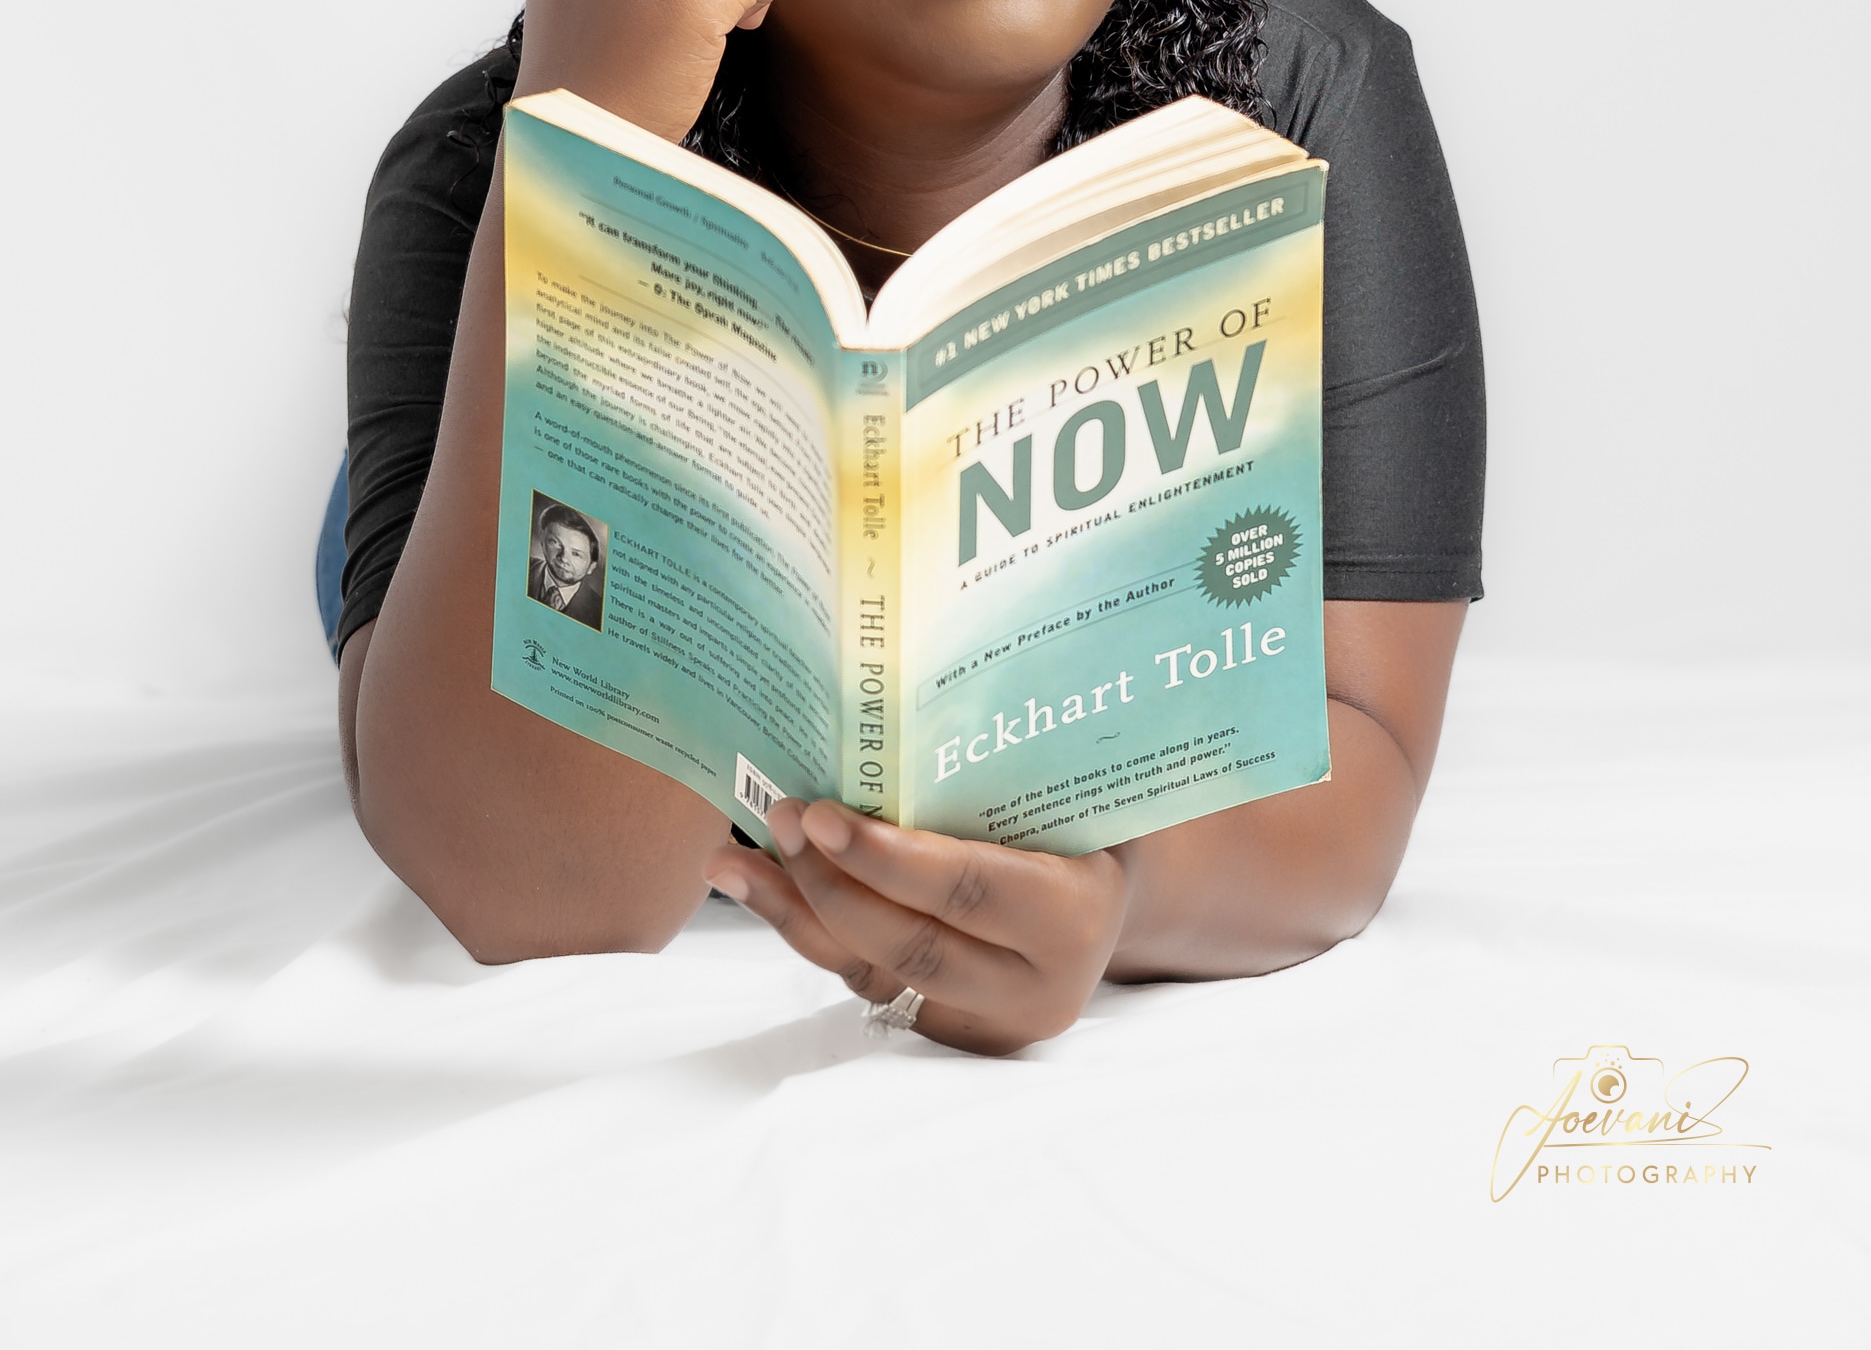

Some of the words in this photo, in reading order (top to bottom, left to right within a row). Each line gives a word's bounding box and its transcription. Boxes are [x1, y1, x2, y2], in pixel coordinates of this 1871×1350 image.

[598, 222, 620, 239] can
[622, 230, 681, 266] transform
[683, 260, 710, 280] your
[934, 340, 958, 368] #1
[963, 309, 1011, 351] NEW
[1014, 281, 1070, 321] YORK
[1074, 249, 1141, 292] TIMES
[1147, 196, 1285, 263] BESTSELLER
[536, 270, 549, 285] To
[551, 280, 577, 298] make
[580, 293, 597, 307] the
[599, 303, 636, 327] journey
[536, 289, 582, 316] analytical
[585, 312, 610, 330] mind
[611, 326, 631, 341] and
[651, 261, 682, 285] More
[707, 289, 735, 312] right
[536, 317, 564, 338] higher
[536, 303, 556, 319] first
[559, 314, 581, 331] page
[618, 343, 682, 381] extraordinary
[536, 334, 552, 348] the
[553, 341, 618, 380] indestructible
[669, 289, 692, 309] The
[694, 301, 729, 328] Oprah
[731, 321, 778, 363] Magazine
[535, 380, 554, 396] and
[556, 391, 568, 403] an
[570, 397, 592, 414] easy
[536, 349, 570, 371] beyond
[573, 368, 589, 382] the
[536, 364, 580, 393] Although
[582, 387, 597, 401] the
[600, 398, 636, 421] journey
[945, 395, 1026, 459] THE
[1047, 326, 1197, 410] POWER
[1219, 296, 1272, 339] OF
[534, 410, 542, 421] A
[544, 415, 614, 458] word-of-mouth
[614, 451, 673, 487] phenomenon
[674, 481, 697, 500] since
[544, 432, 560, 446] one
[562, 441, 573, 451] of
[574, 446, 599, 465] those
[601, 461, 621, 476] rare
[622, 469, 650, 491] books
[651, 487, 672, 503] with
[673, 497, 688, 511] the
[689, 506, 716, 527] power
[862, 414, 888, 488] Eckhart
[958, 339, 1268, 568] NOW
[547, 451, 564, 464] one
[567, 459, 587, 475] that
[588, 470, 606, 485] can
[608, 480, 649, 507] radically
[651, 502, 685, 527] change
[686, 519, 708, 538] their
[710, 535, 730, 554] lives
[862, 493, 887, 541] Tolle
[960, 580, 968, 591] A
[974, 554, 1017, 582] GUIDE
[1023, 543, 1039, 557] TO
[1046, 509, 1121, 548] SPIRITUAL
[1128, 459, 1256, 514] ENLIGHTENMENT
[1231, 524, 1268, 546] OVER
[613, 530, 660, 561] ECKHART
[661, 555, 691, 578] TOLLE
[1215, 552, 1225, 566] 5
[1227, 533, 1284, 562] MILLION
[1224, 551, 1275, 577] COPIES
[1231, 568, 1268, 589] SOLD
[610, 579, 646, 603] spiritual
[647, 598, 681, 621] masters
[682, 617, 698, 631] and
[699, 626, 729, 652] imparts
[610, 594, 634, 613] There
[637, 608, 646, 620] is
[659, 620, 676, 635] way
[679, 631, 693, 645] out
[611, 548, 627, 560] not
[628, 554, 659, 576] aligned
[660, 572, 679, 588] with
[680, 584, 696, 598] any
[697, 592, 735, 623] particular
[611, 564, 630, 579] with
[634, 575, 648, 587] the
[651, 583, 685, 607] timeless
[688, 604, 704, 618] and
[706, 615, 759, 660] uncomplicated
[607, 611, 637, 630] author
[639, 626, 649, 637] of
[650, 631, 686, 657] Stillness
[687, 652, 716, 676] Speaks
[717, 672, 731, 687] and
[860, 594, 885, 648] THE
[935, 665, 967, 690] With
[971, 659, 979, 669] a
[983, 642, 1012, 663] New
[1017, 616, 1071, 646] Preface
[1076, 607, 1092, 621] by
[1098, 595, 1120, 613] the
[1125, 577, 1176, 603] Author
[552, 656, 571, 672] New
[573, 665, 599, 685] World
[600, 680, 631, 701] Library
[607, 627, 620, 640] He
[622, 634, 651, 655] travels
[652, 649, 680, 669] widely
[681, 664, 697, 679] and
[698, 674, 715, 691] lives
[549, 685, 575, 703] Printed
[575, 698, 585, 708] on
[606, 713, 654, 739] postconsumer
[674, 746, 701, 766] recycled
[551, 668, 661, 725] www.newworldlibrary.com
[859, 661, 885, 752] POWER
[933, 670, 1135, 785] Eckhart
[1154, 621, 1287, 690] Tolle
[859, 760, 884, 794] OF
[979, 803, 1007, 819] “One
[1010, 795, 1022, 809] of
[1025, 788, 1043, 803] the
[1046, 778, 1070, 795] best
[1073, 767, 1108, 786] books
[1110, 762, 1123, 773] to
[1126, 752, 1157, 768] come
[1159, 741, 1190, 757] along
[1193, 734, 1204, 747] in
[1207, 726, 1240, 744] years.
[987, 814, 1019, 833] Every
[1022, 795, 1072, 819] sentence
[1075, 785, 1103, 802] rings
[1106, 776, 1131, 791] with
[1134, 764, 1163, 781] truth
[1166, 757, 1187, 772] and
[1190, 742, 1232, 765] power.”
[999, 825, 1040, 847] Chopra,
[1041, 814, 1075, 832] author
[1078, 807, 1090, 820] of
[1091, 801, 1111, 816] The
[1114, 792, 1144, 808] Seven
[1146, 776, 1191, 798] Spiritual
[1193, 768, 1219, 783] Laws
[1221, 762, 1233, 774] of
[1235, 750, 1277, 769] Success
